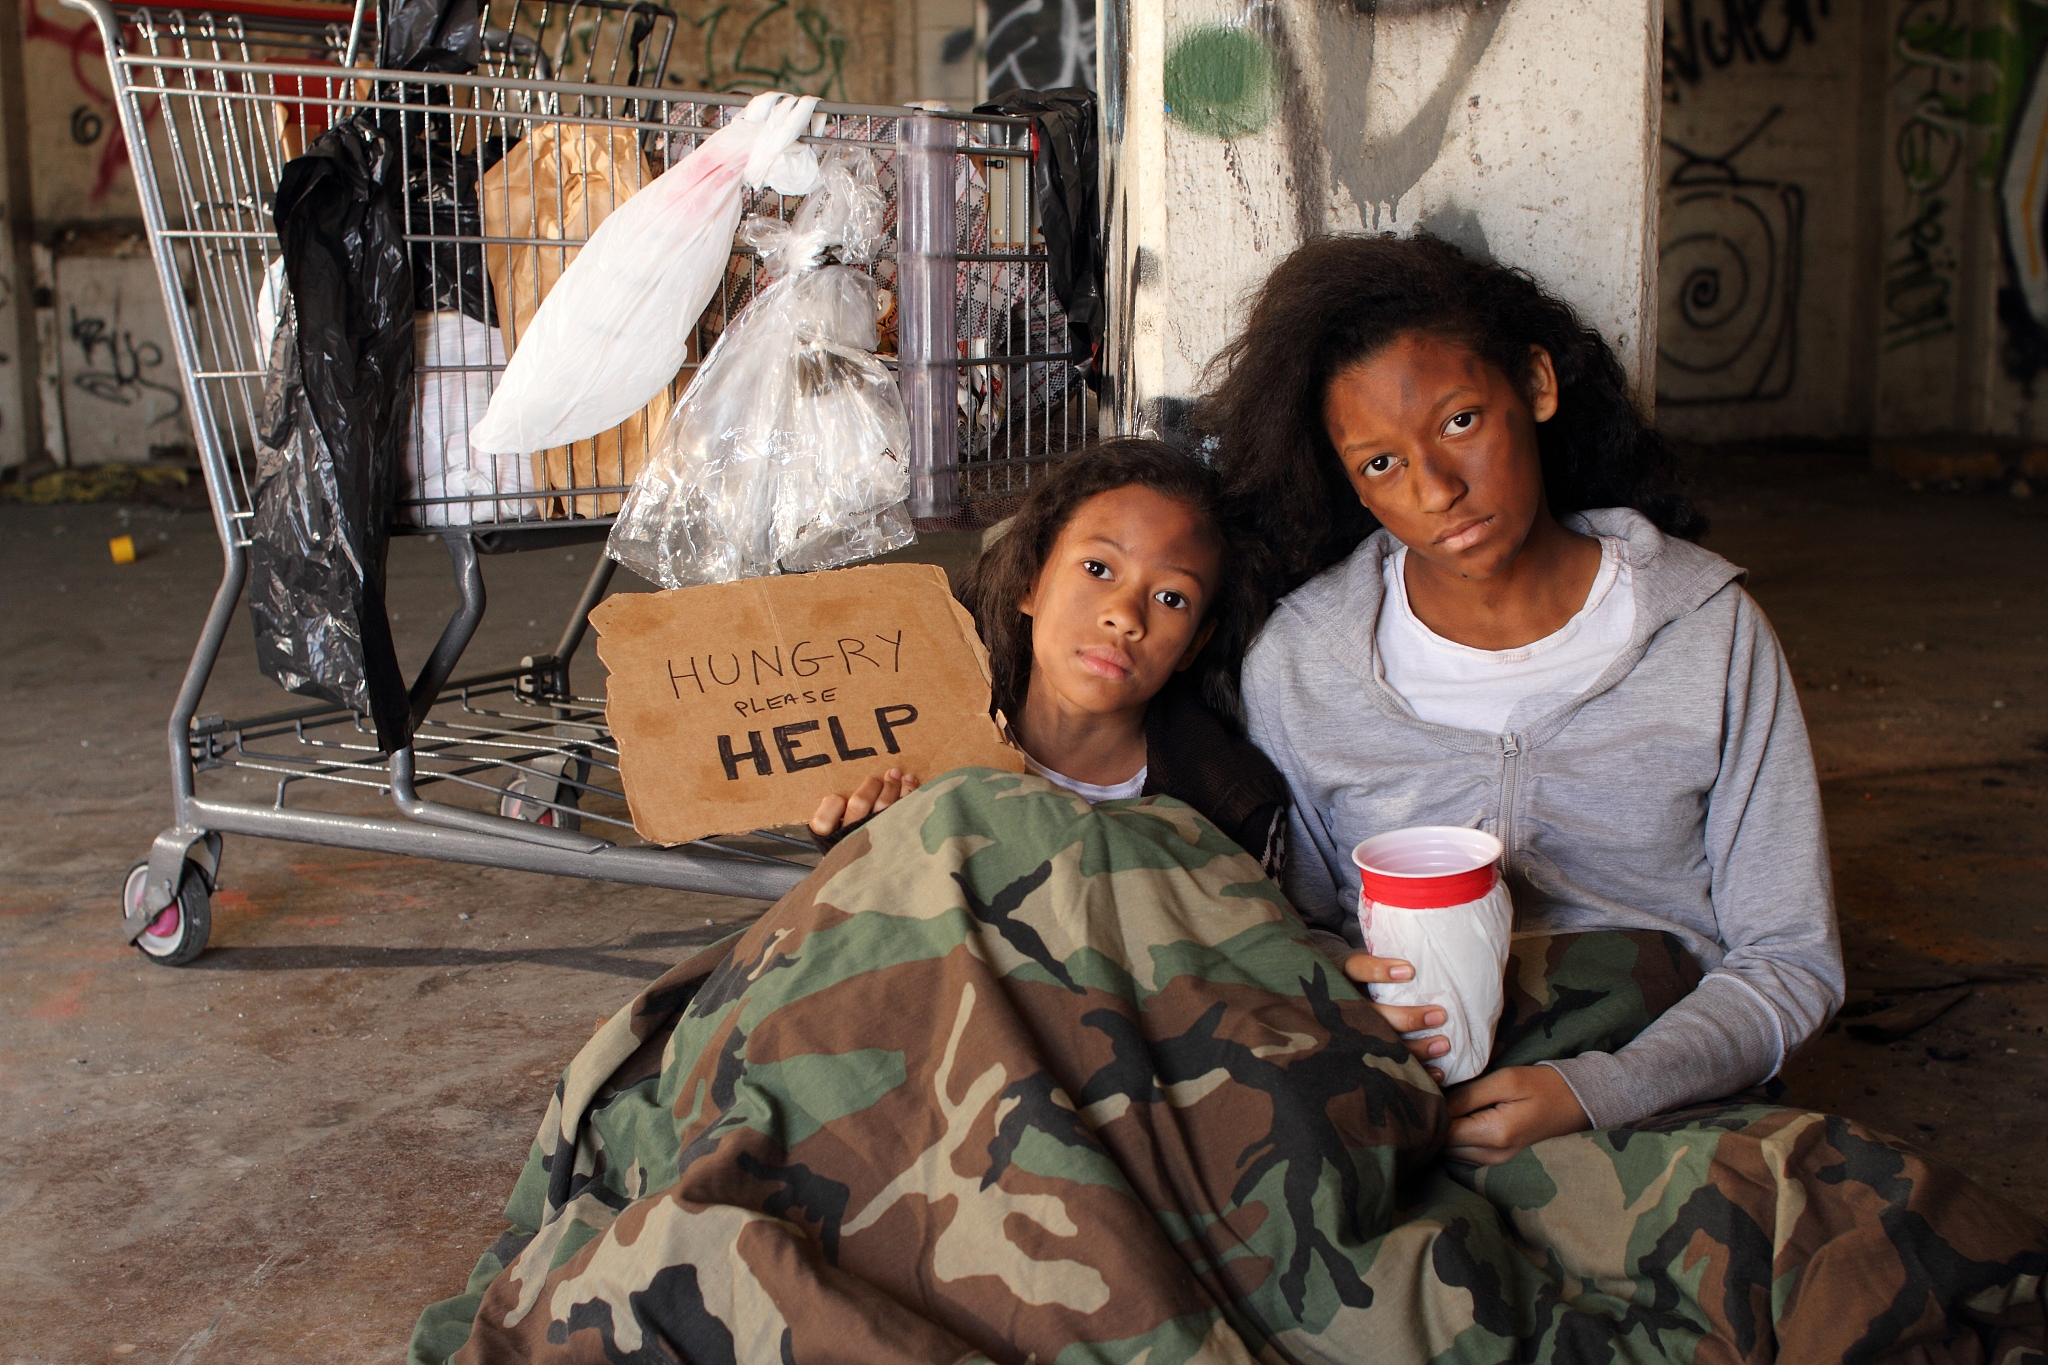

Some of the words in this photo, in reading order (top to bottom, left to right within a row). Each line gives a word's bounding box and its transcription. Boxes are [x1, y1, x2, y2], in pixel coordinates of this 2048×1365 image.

[667, 630, 902, 700] HUNGRY
[734, 687, 838, 718] PLEASE
[717, 703, 919, 781] HELP
